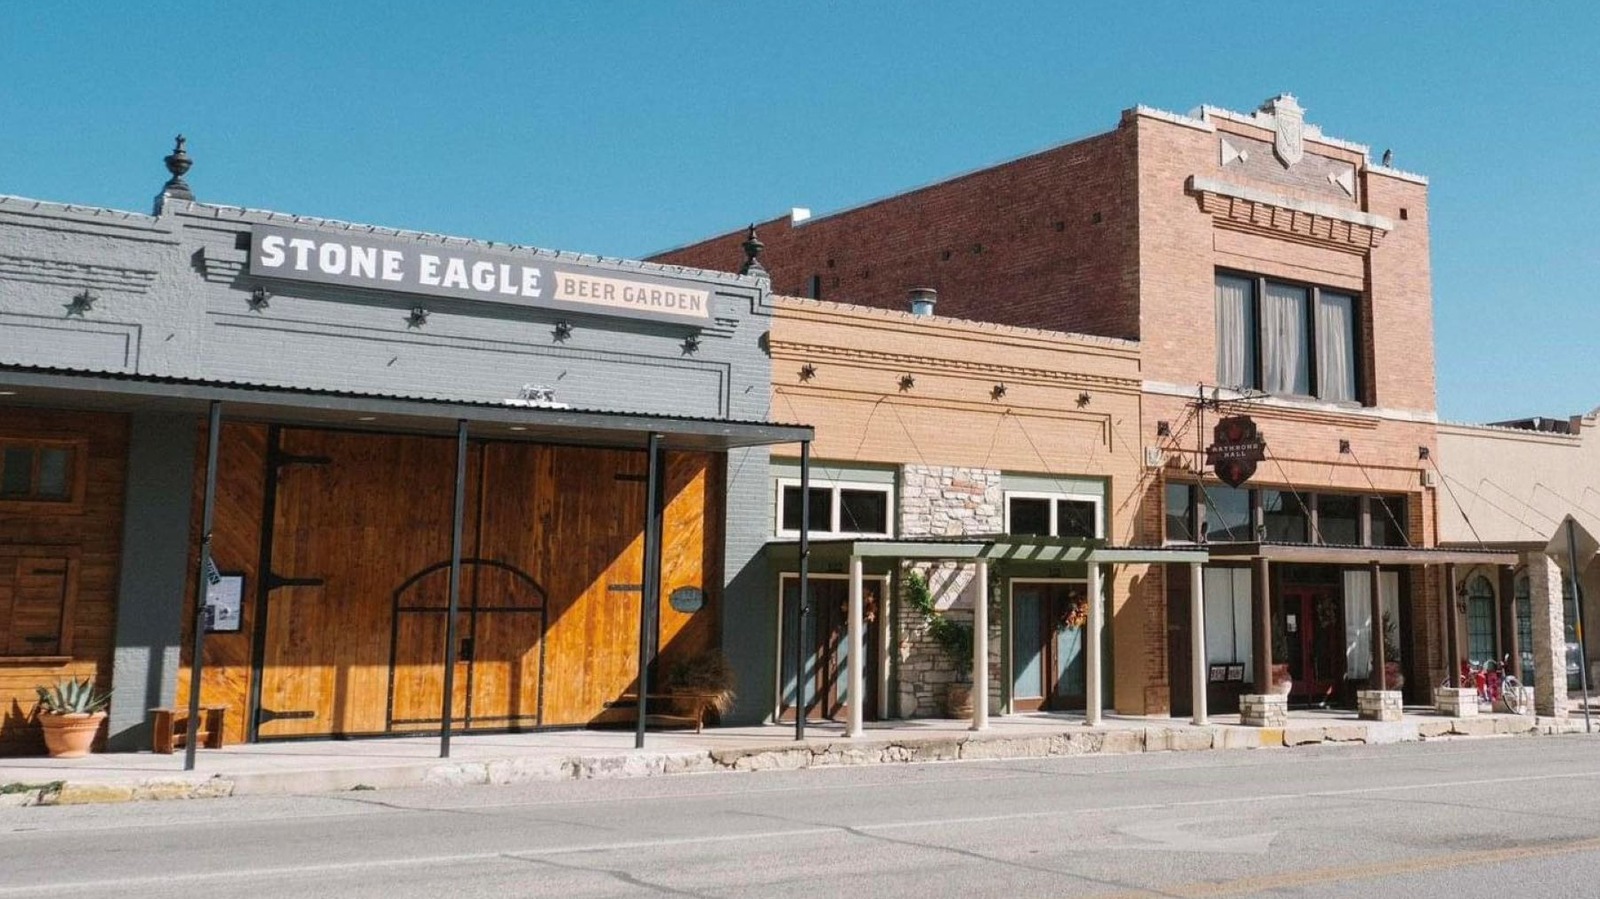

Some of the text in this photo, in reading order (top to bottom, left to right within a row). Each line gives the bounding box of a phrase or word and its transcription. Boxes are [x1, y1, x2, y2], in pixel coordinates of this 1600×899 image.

[261, 235, 542, 298] STONE EAGLE
[564, 278, 701, 311] BEER GARDEN
